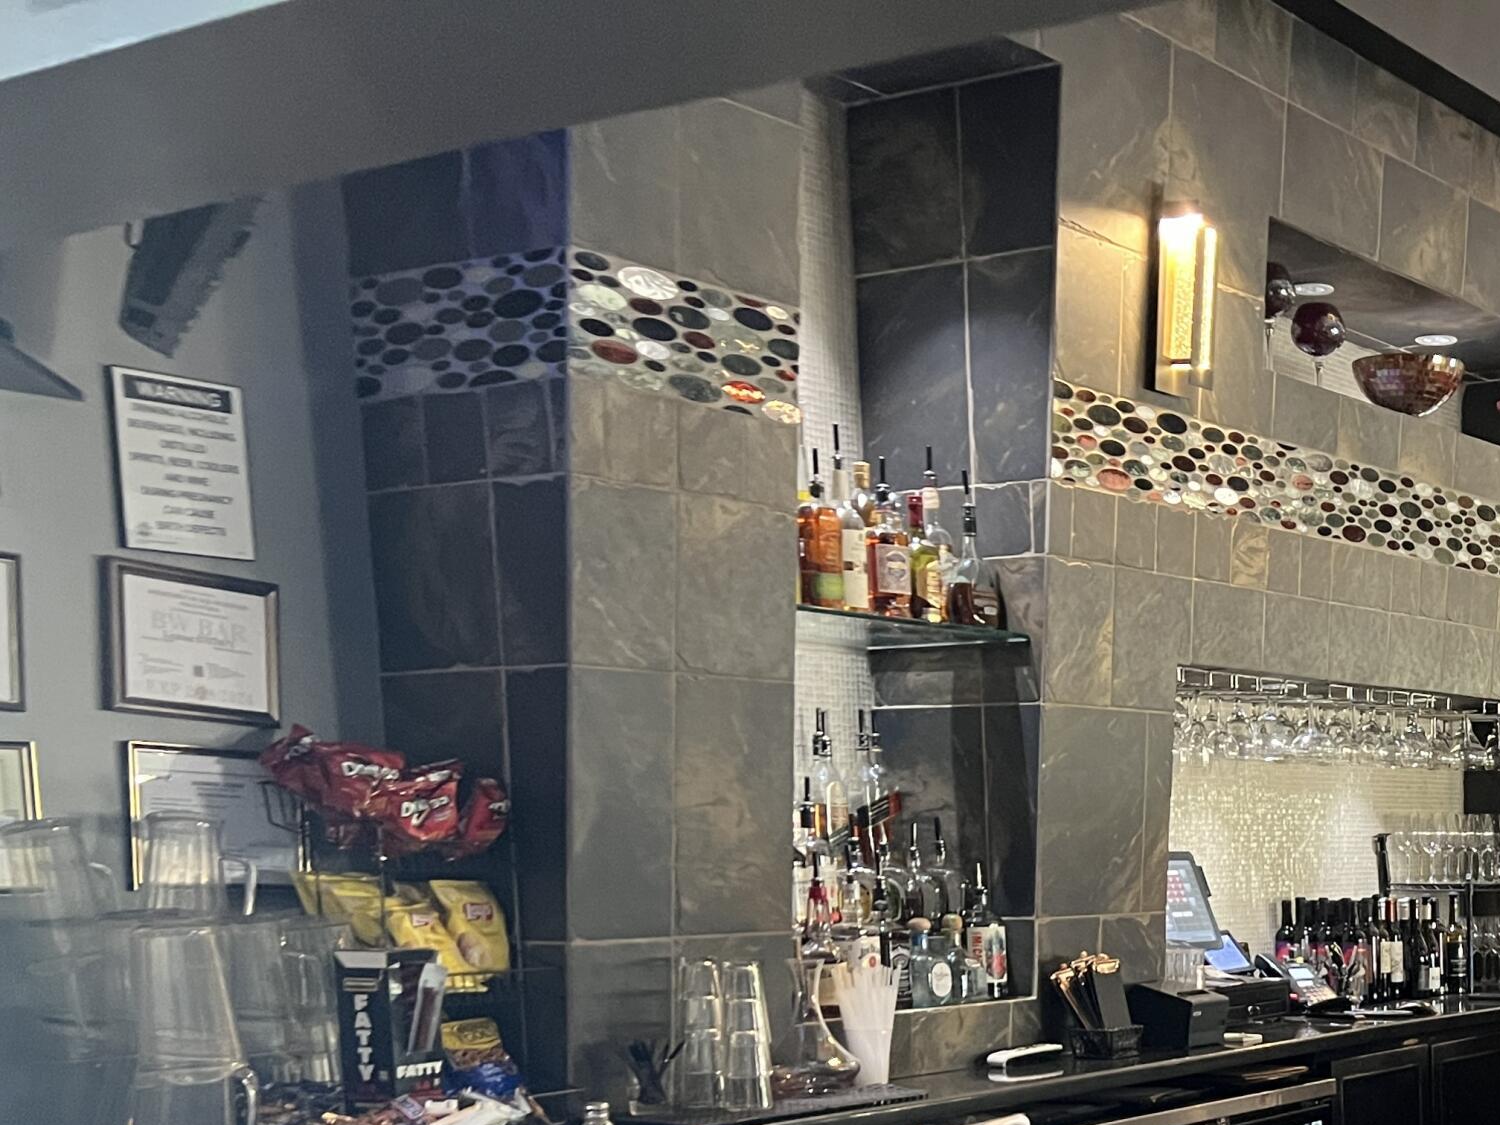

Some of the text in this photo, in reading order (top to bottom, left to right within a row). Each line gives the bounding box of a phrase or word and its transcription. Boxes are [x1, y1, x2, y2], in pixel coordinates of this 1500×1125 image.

[134, 379, 222, 408] WARNING
[354, 993, 375, 1082] FATTY
[396, 1060, 444, 1080] FATTY
